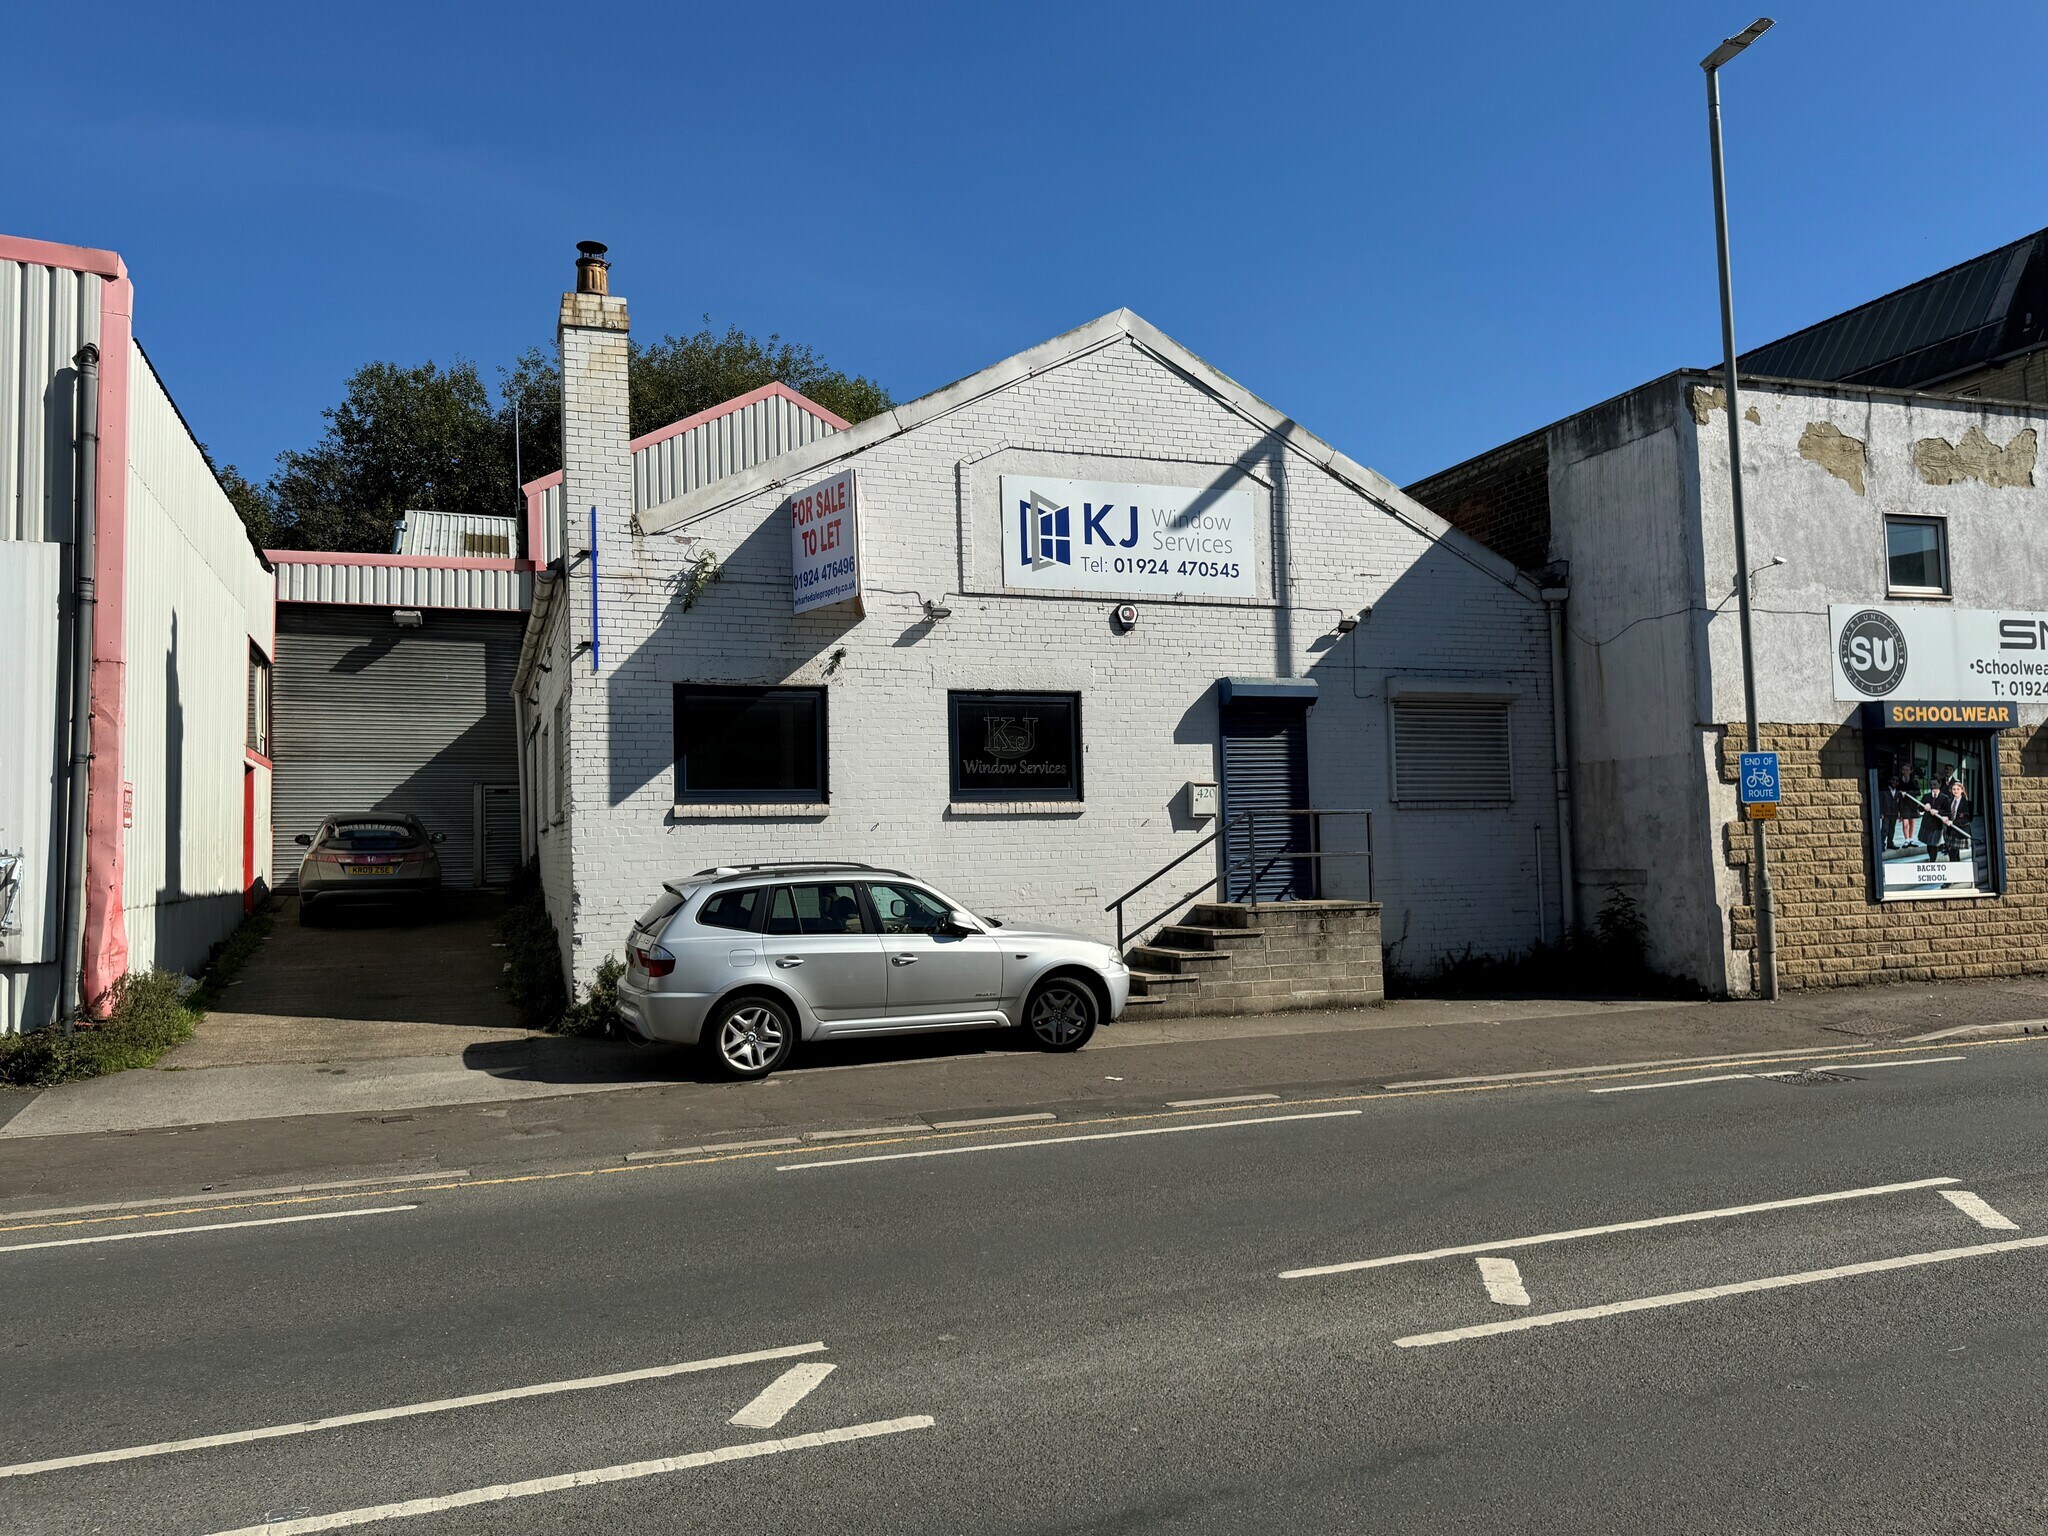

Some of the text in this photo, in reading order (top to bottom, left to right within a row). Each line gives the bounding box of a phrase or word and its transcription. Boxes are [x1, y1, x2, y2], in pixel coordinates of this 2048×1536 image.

[791, 495, 813, 529] FOR
[816, 481, 846, 519] SALE
[1083, 502, 1139, 549] KJ
[1151, 507, 1232, 531] Window
[801, 518, 842, 558] TO LET
[1152, 529, 1234, 554] Services
[793, 555, 856, 591] 01924 476496
[1080, 555, 1240, 579] Tel: 01924 470545
[1999, 619, 2048, 651] S
[1850, 635, 1896, 672] SU
[1869, 672, 1901, 693] SMART
[1991, 680, 2005, 696] T:
[1892, 706, 2010, 723] SCHOOLWEAR
[983, 716, 1039, 752] KJ
[962, 757, 1068, 774] Window Services
[1744, 757, 1773, 766] END OF
[1748, 789, 1774, 798] ROUTE
[1916, 864, 1947, 872] BACK TO
[1917, 874, 1947, 882] SCHOOL
